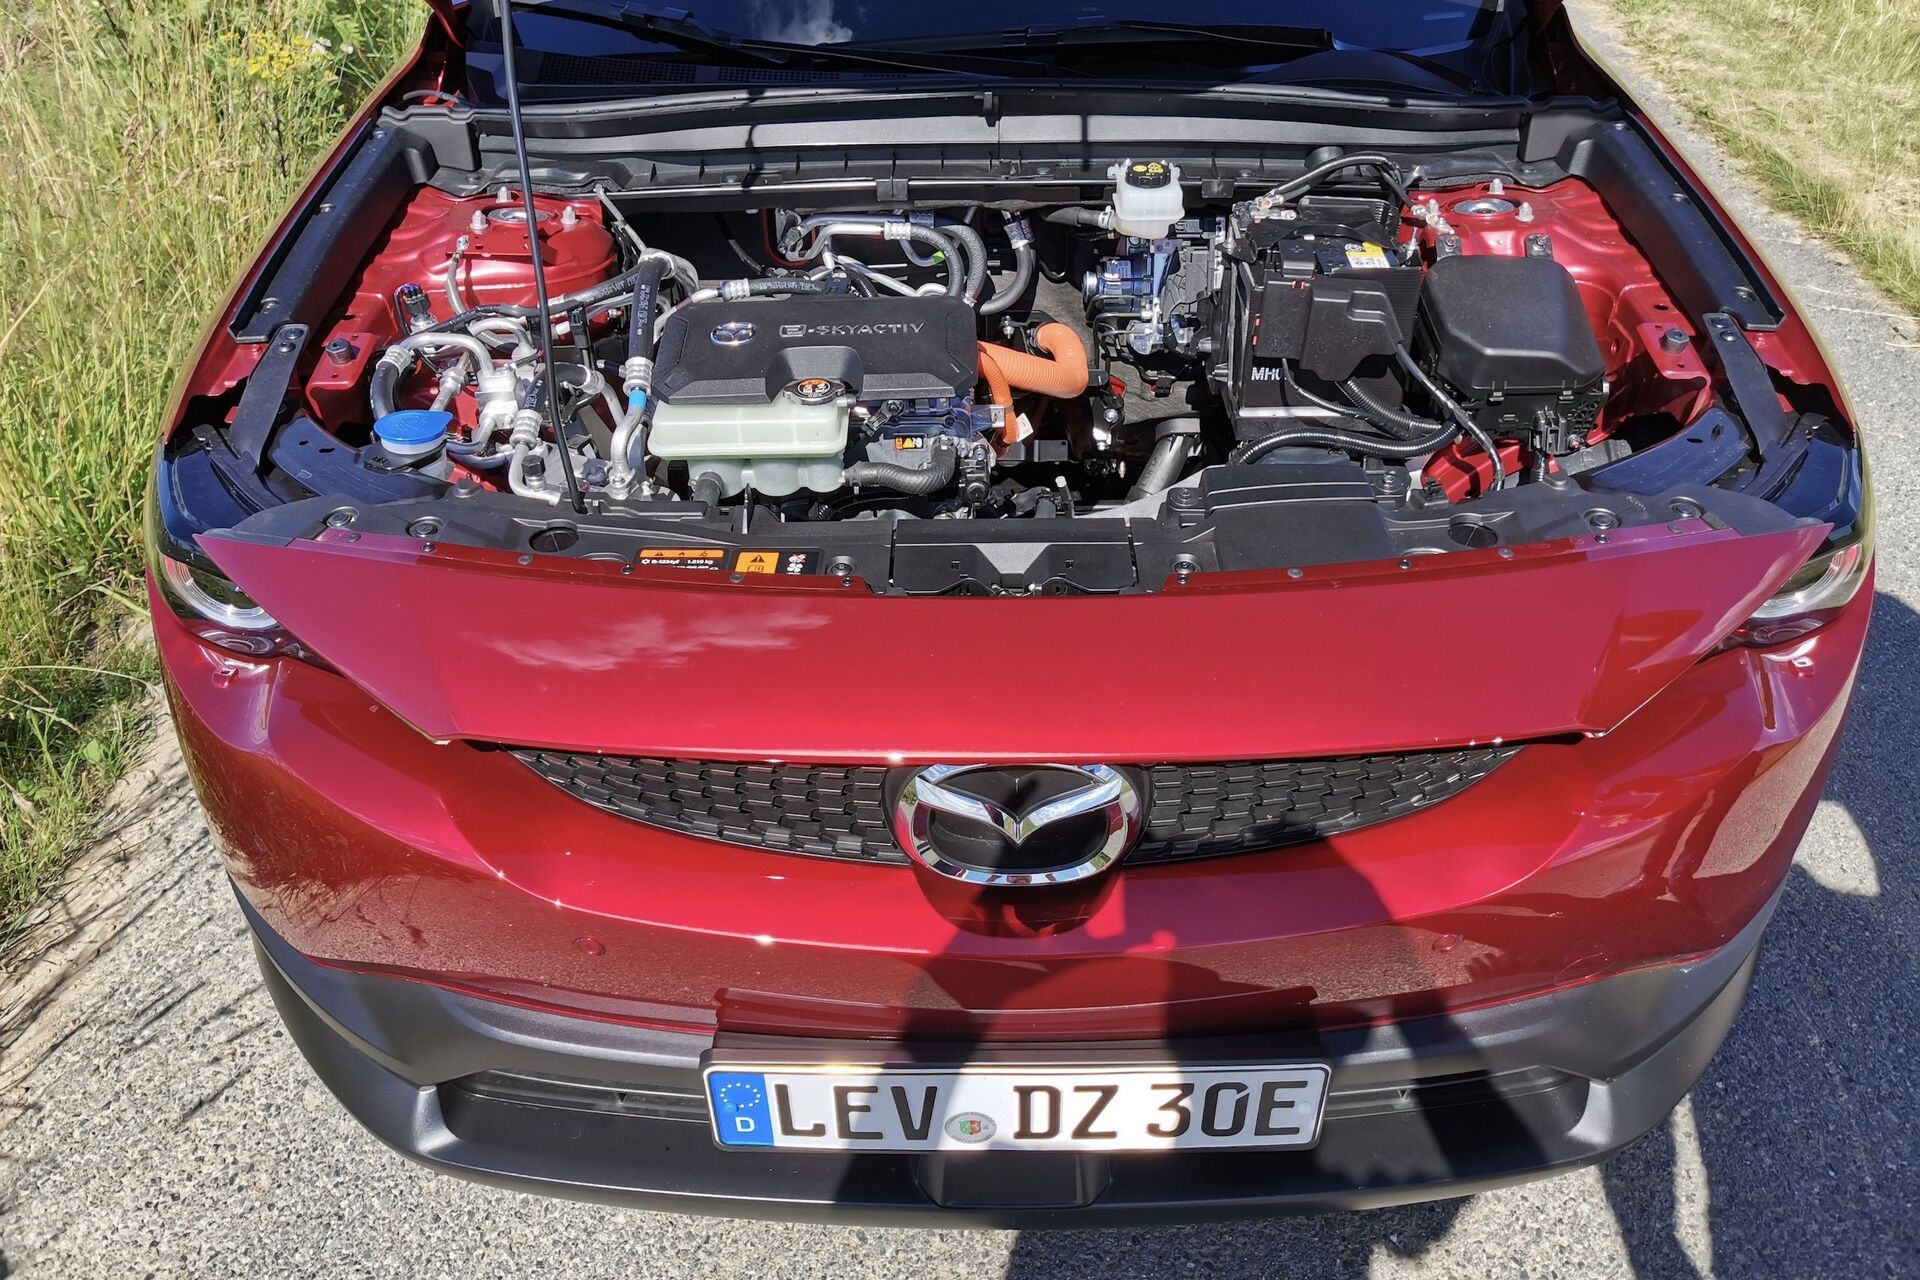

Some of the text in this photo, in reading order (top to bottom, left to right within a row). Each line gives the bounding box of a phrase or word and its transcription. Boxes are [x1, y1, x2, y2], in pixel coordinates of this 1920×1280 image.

[735, 1116, 755, 1133] D
[774, 1080, 1308, 1140] LEV DZ 30E
